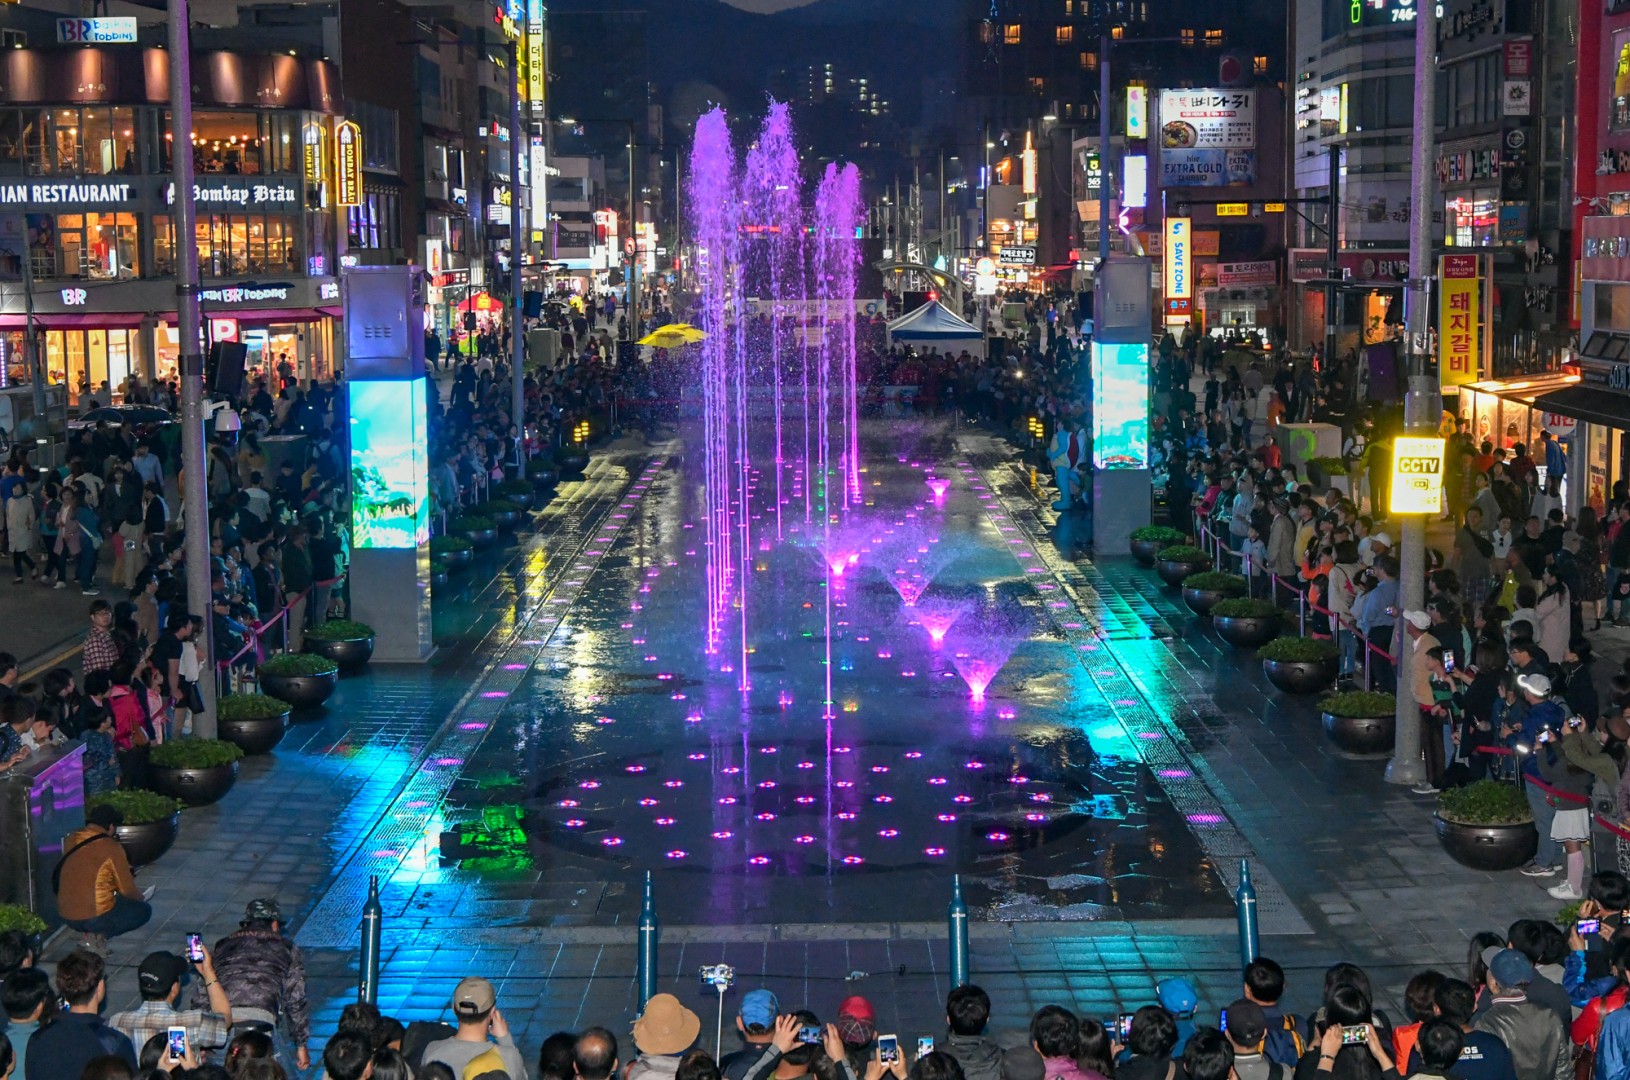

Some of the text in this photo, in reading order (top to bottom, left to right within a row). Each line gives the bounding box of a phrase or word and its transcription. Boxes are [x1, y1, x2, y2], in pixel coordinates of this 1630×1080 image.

[60, 19, 91, 41] BR
[346, 143, 354, 178] BOMBAY
[1164, 163, 1222, 174] EXTRA COLD
[32, 184, 129, 203] RESTAURANT
[193, 185, 248, 204] Bombay
[1174, 242, 1183, 266] SAVE
[1174, 269, 1183, 293] ZONE
[62, 289, 86, 305] BR
[222, 288, 243, 302] BR
[1449, 292, 1471, 375] 돼지갈비
[1400, 458, 1438, 473] CCTV
